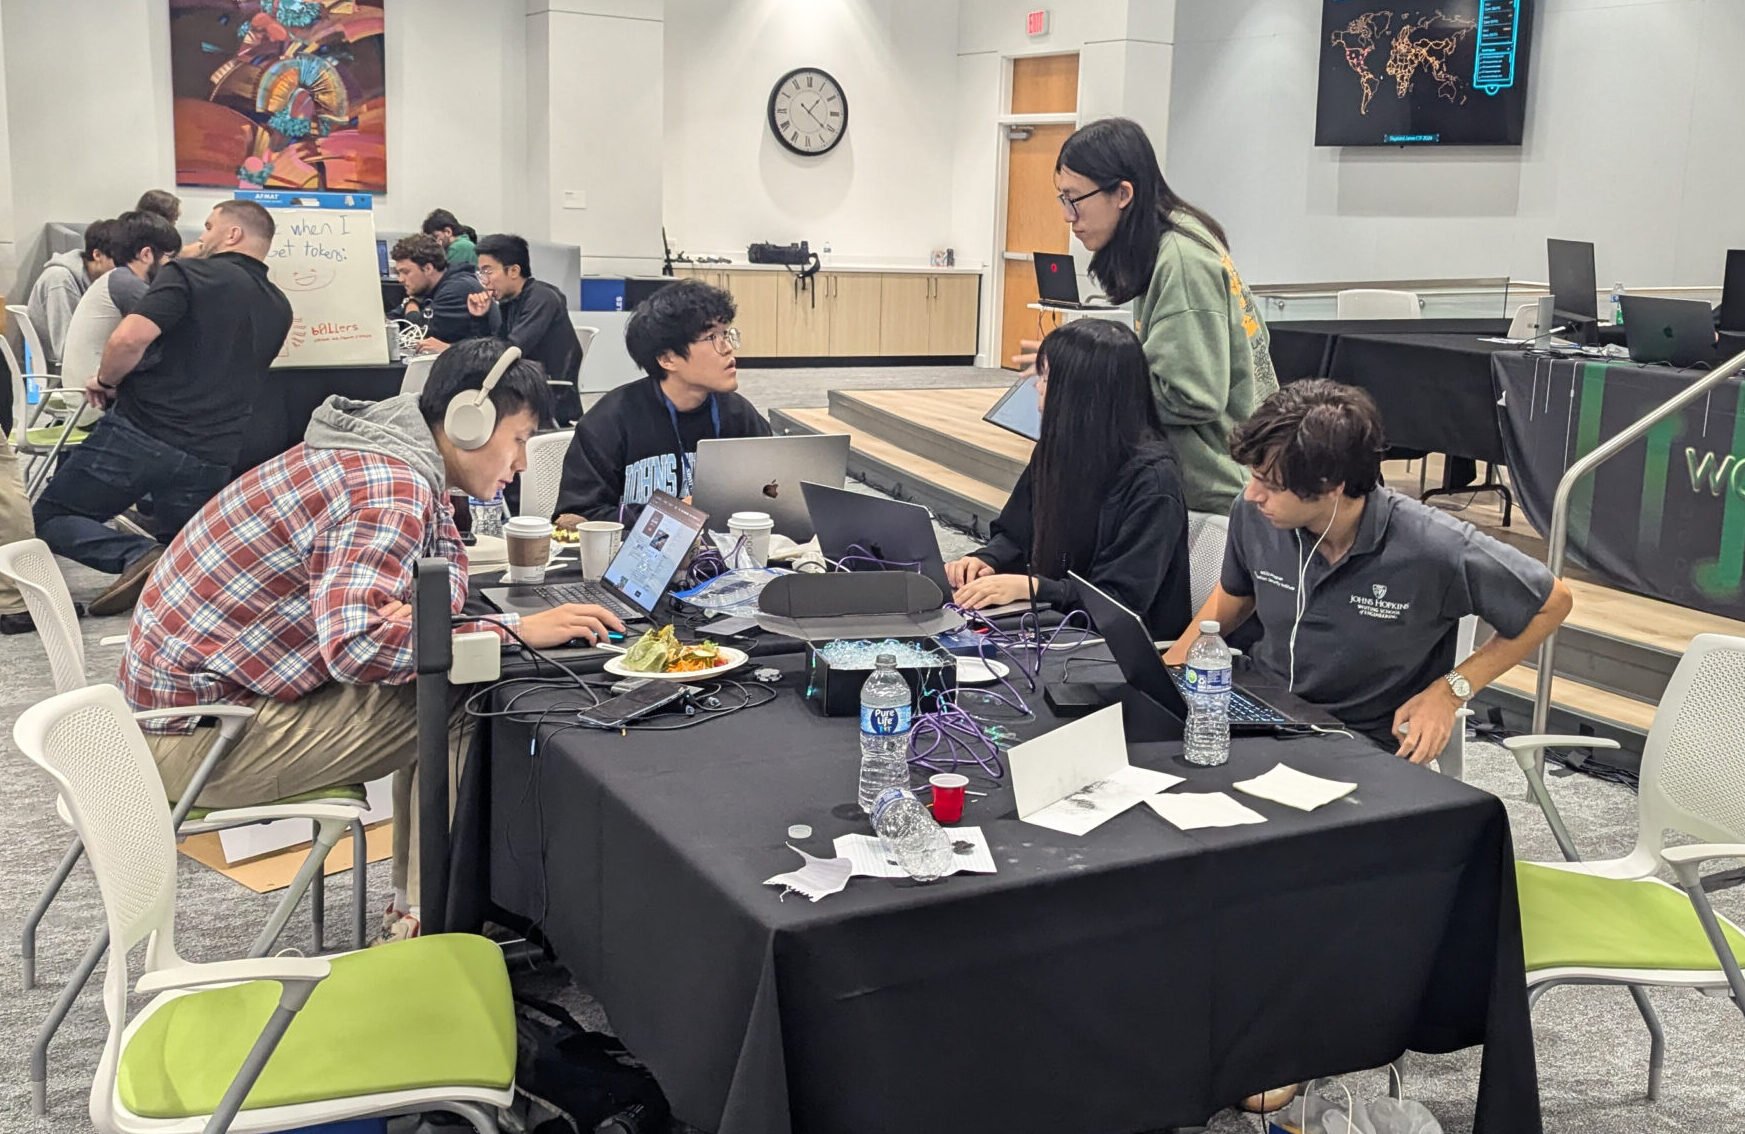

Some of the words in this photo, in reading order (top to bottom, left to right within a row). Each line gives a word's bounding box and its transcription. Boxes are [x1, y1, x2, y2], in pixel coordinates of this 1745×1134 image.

[290, 218, 332, 236] when
[1349, 594, 1373, 606] JOHNS
[875, 709, 895, 717] Pure
[877, 717, 893, 727] Life
